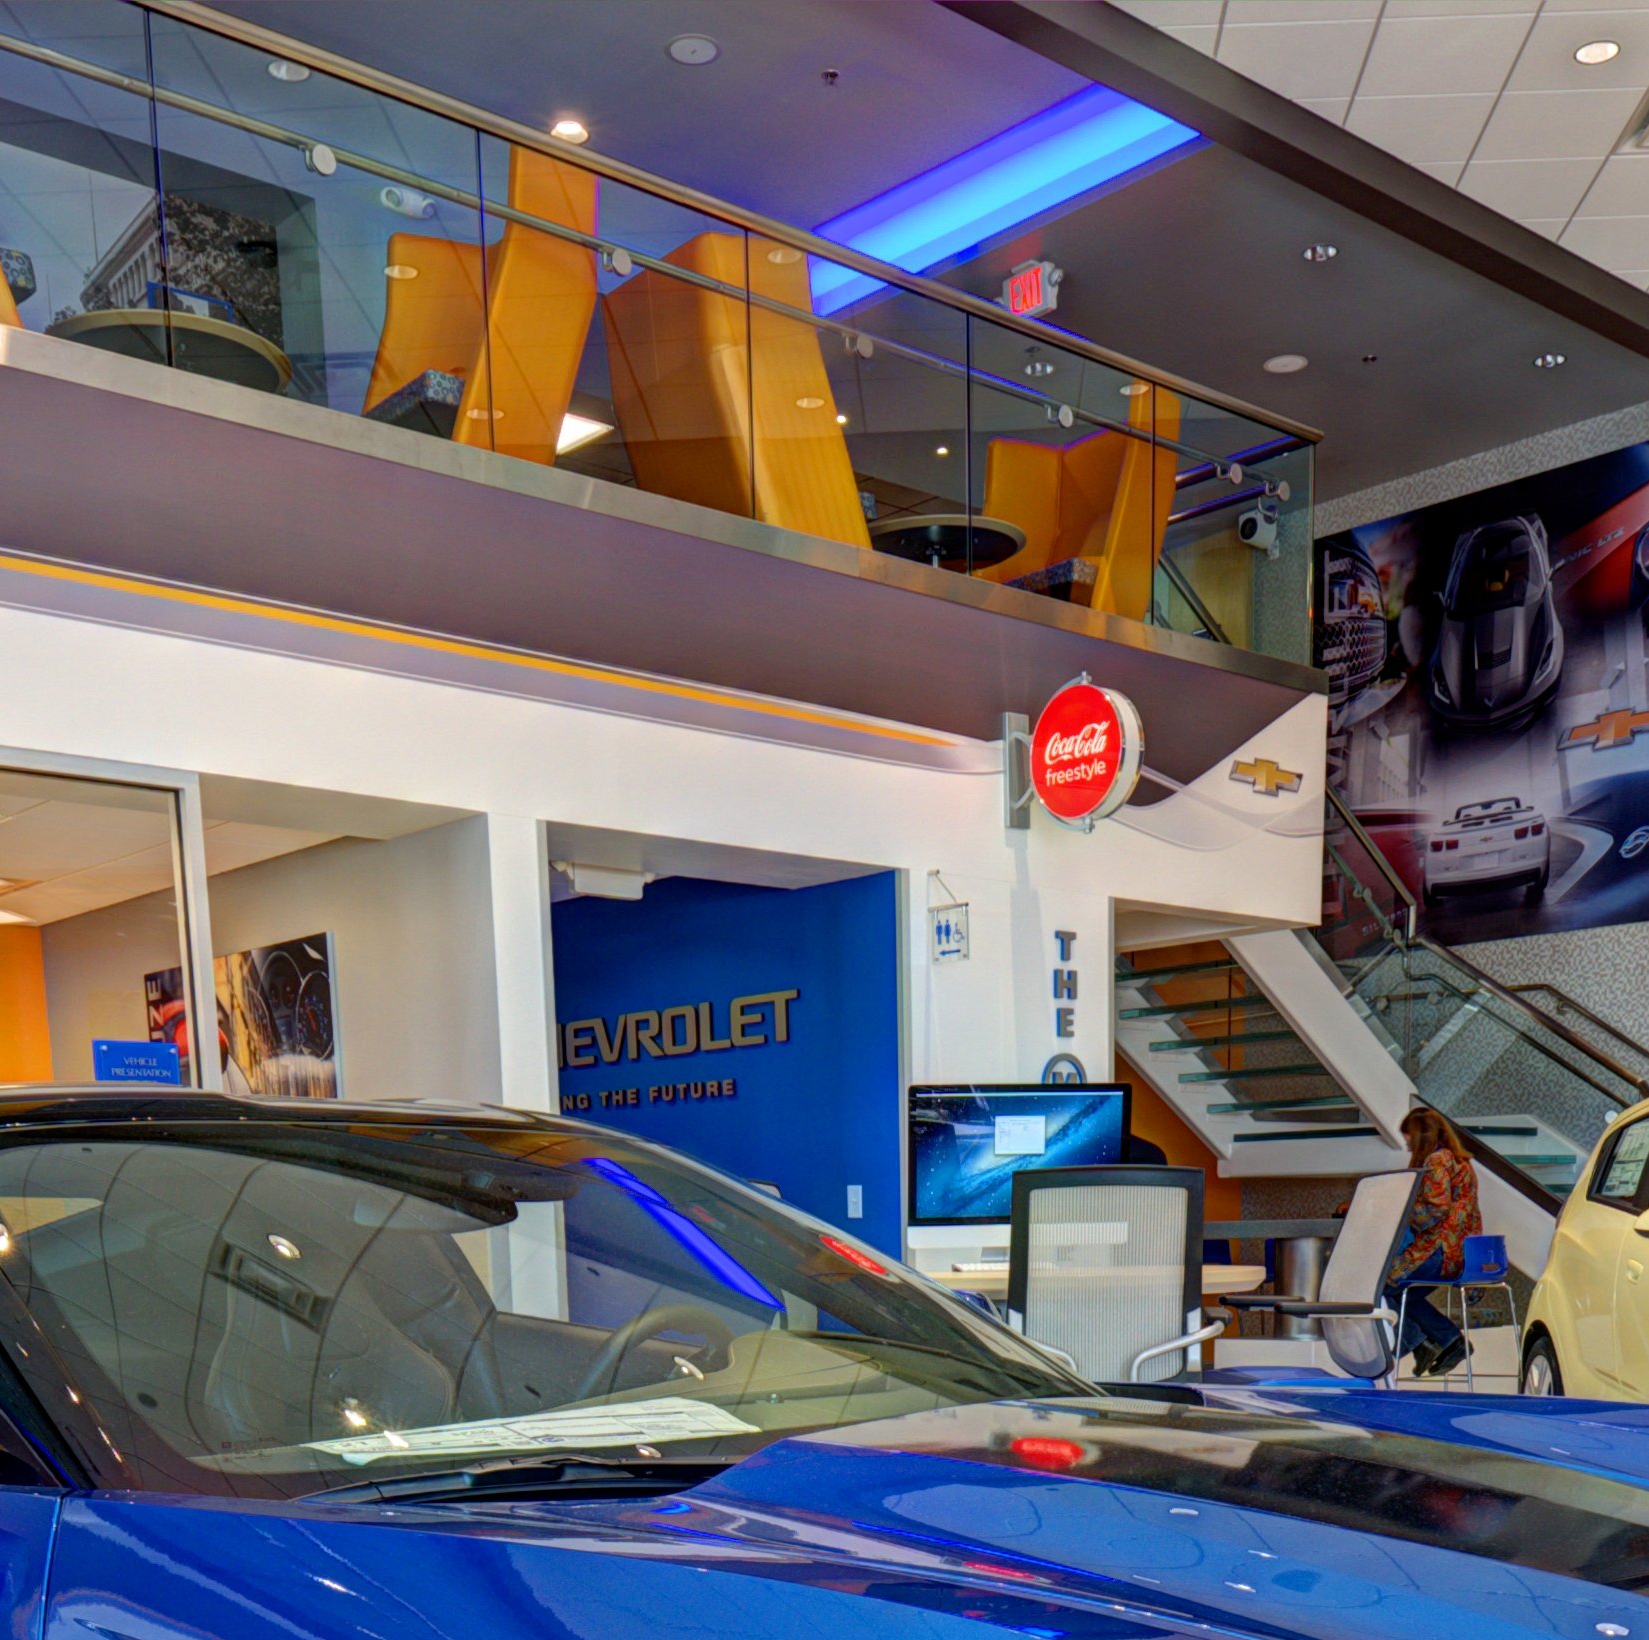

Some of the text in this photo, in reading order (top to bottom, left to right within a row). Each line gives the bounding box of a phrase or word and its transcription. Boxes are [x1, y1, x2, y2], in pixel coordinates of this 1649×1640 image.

[1009, 266, 1042, 314] EXIT
[1044, 720, 1111, 765] Coca-Cola
[1045, 758, 1107, 787] freestyle
[1053, 930, 1078, 1038] THE
[557, 988, 799, 1068] EVROLET
[111, 1067, 172, 1078] PRESENTATION
[123, 1057, 158, 1066] VEHICLE
[599, 1088, 638, 1106] THE
[649, 1078, 735, 1102] FUTURE
